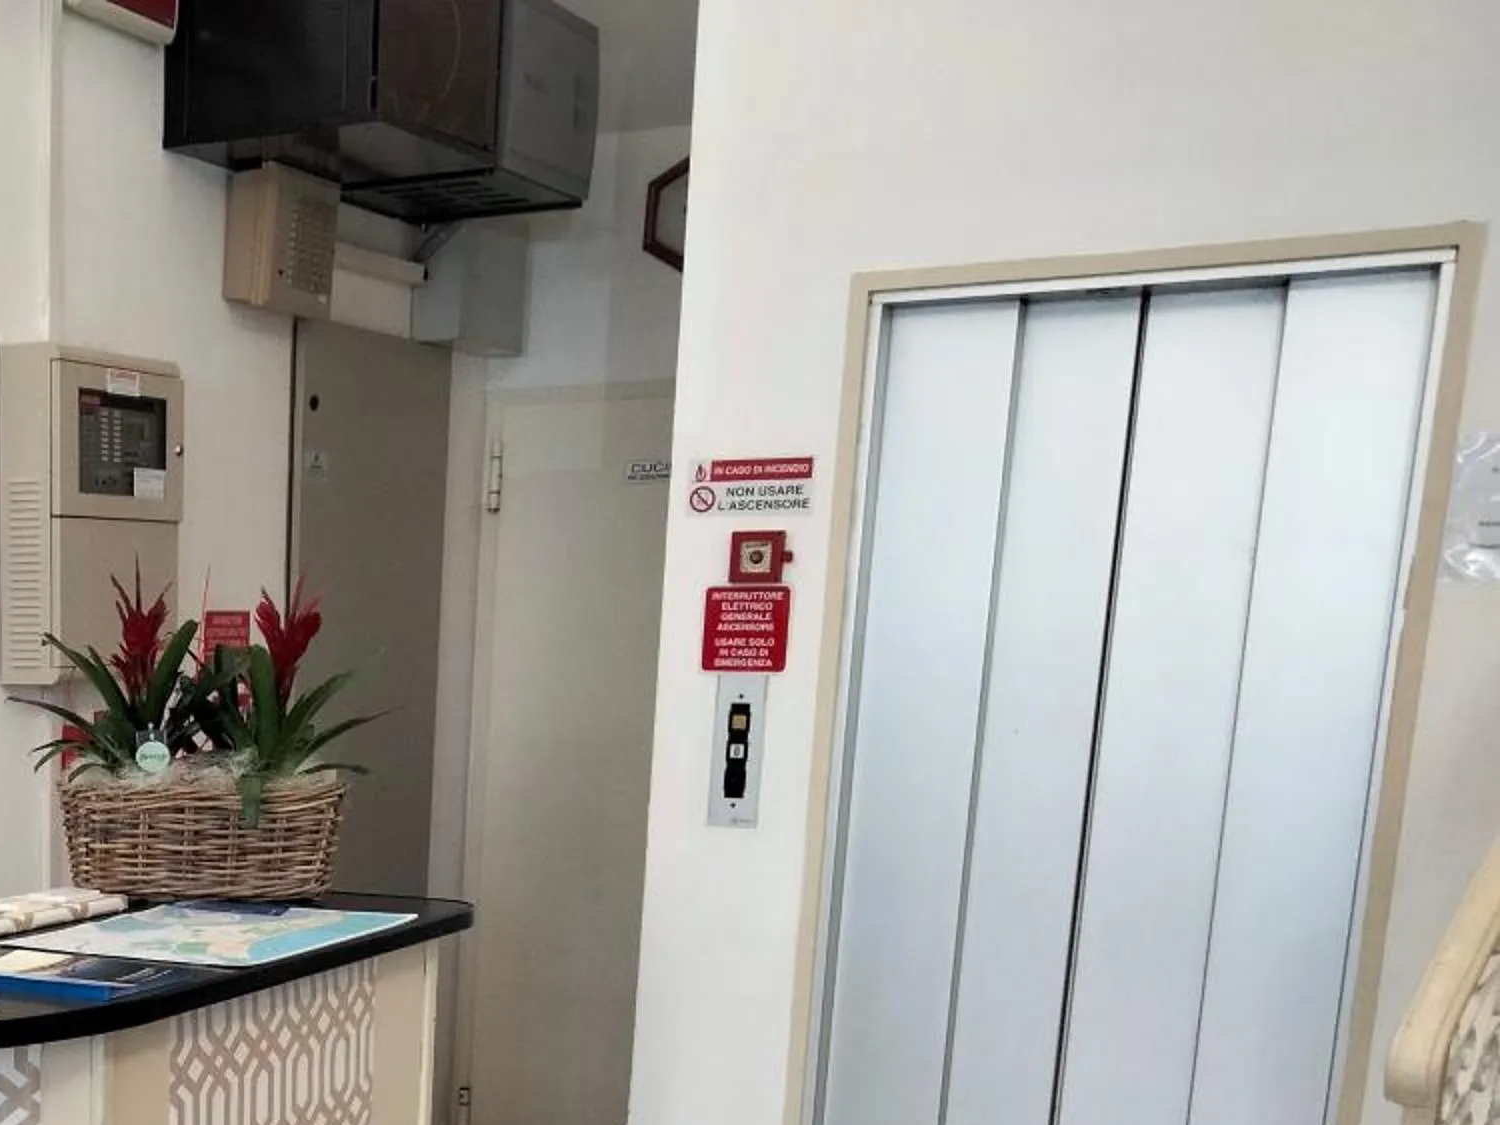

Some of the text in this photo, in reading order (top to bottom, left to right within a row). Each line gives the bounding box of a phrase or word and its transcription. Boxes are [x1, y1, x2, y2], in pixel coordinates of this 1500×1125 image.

[631, 463, 671, 473] CUCI
[714, 463, 809, 475] IN CASO DI INCENDIO
[726, 484, 805, 497] NON USARE
[717, 497, 810, 511] L'ASCENSORE
[711, 591, 785, 601] INTERRUTTORE
[721, 601, 773, 611] ELETTRICO
[720, 611, 772, 621] GENERALE
[713, 637, 775, 647] USARE SOLO
[718, 647, 769, 657] IN CASO DI
[713, 657, 773, 667] EMERGENZA
